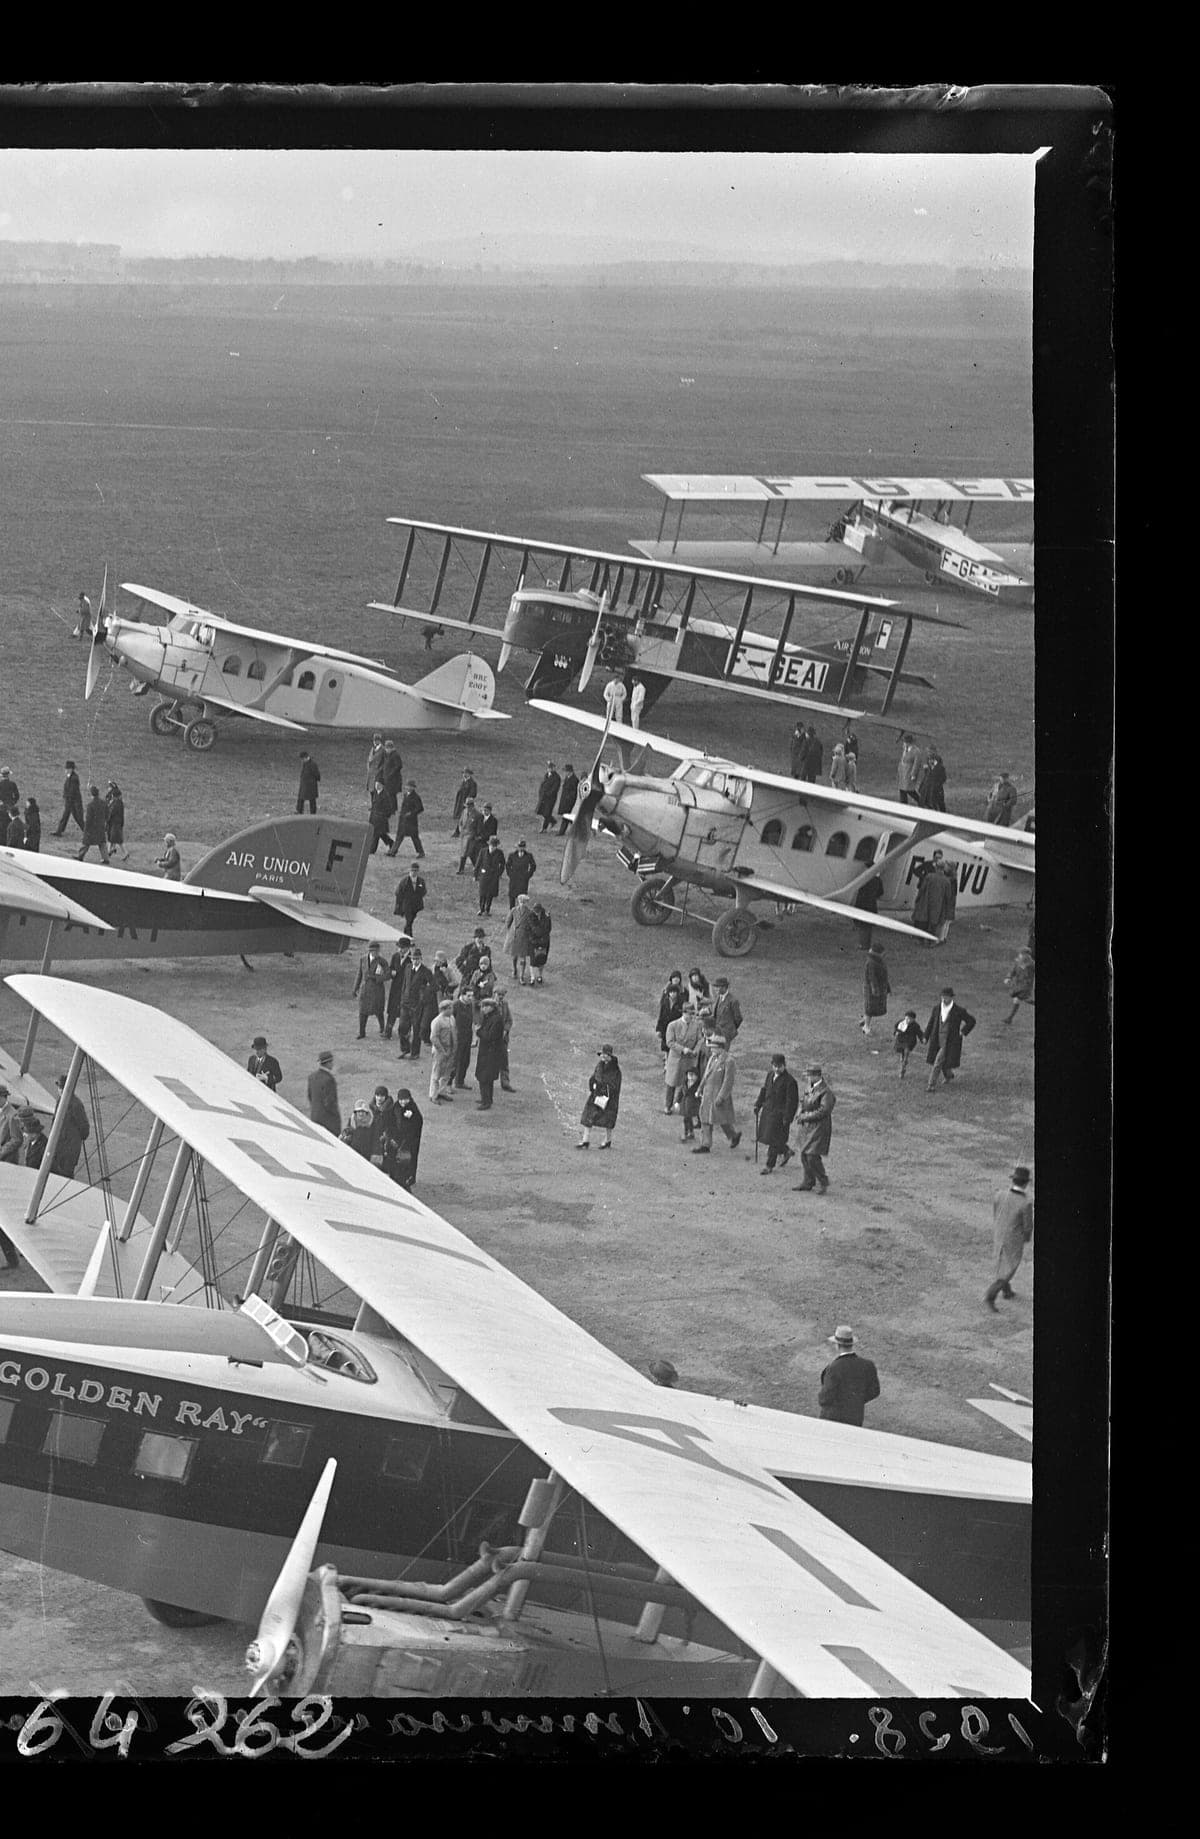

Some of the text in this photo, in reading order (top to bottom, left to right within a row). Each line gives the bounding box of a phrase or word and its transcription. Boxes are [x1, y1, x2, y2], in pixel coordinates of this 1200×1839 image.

[877, 620, 892, 646] F
[226, 851, 311, 877] AIR UNION
[326, 839, 352, 872] F
[256, 872, 284, 883] PARIS
